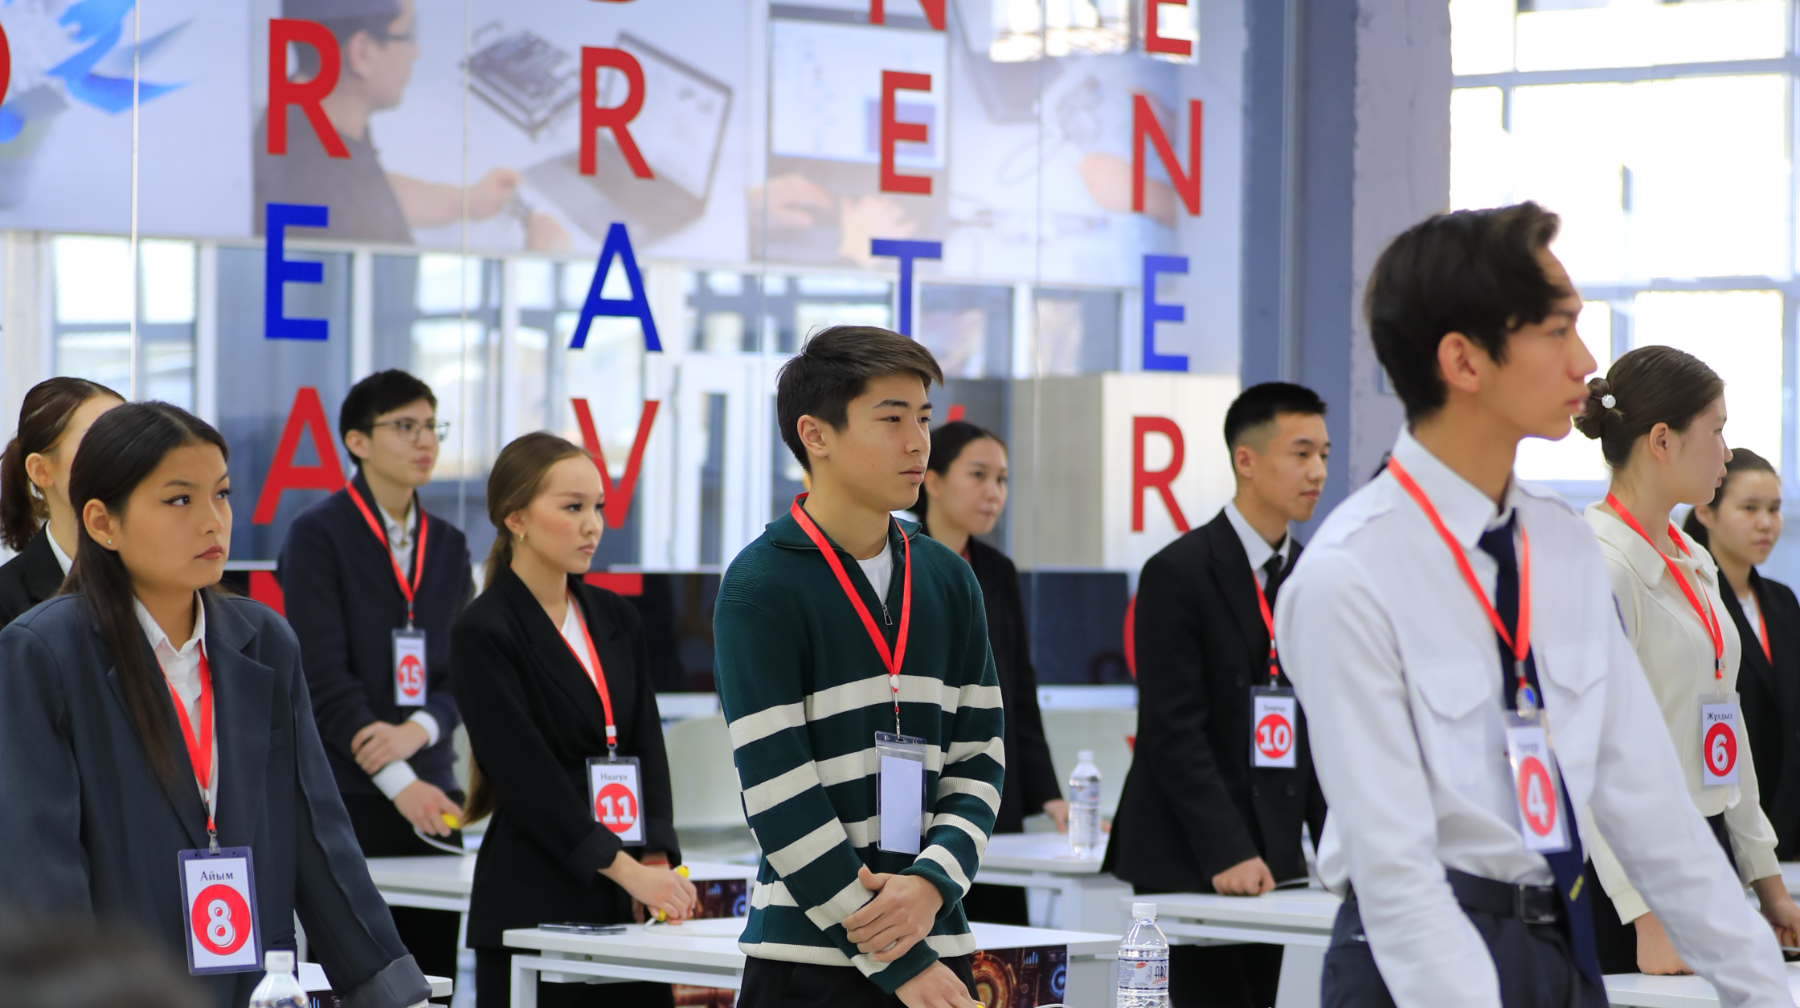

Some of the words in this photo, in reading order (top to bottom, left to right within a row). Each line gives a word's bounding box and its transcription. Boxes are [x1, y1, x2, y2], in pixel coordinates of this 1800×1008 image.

[401, 664, 422, 690] 15
[1259, 724, 1291, 752] 10
[1711, 733, 1729, 772] 6
[600, 795, 635, 825] 11
[1526, 772, 1548, 828] 4
[200, 870, 234, 882] Айым
[207, 899, 236, 949] 8
